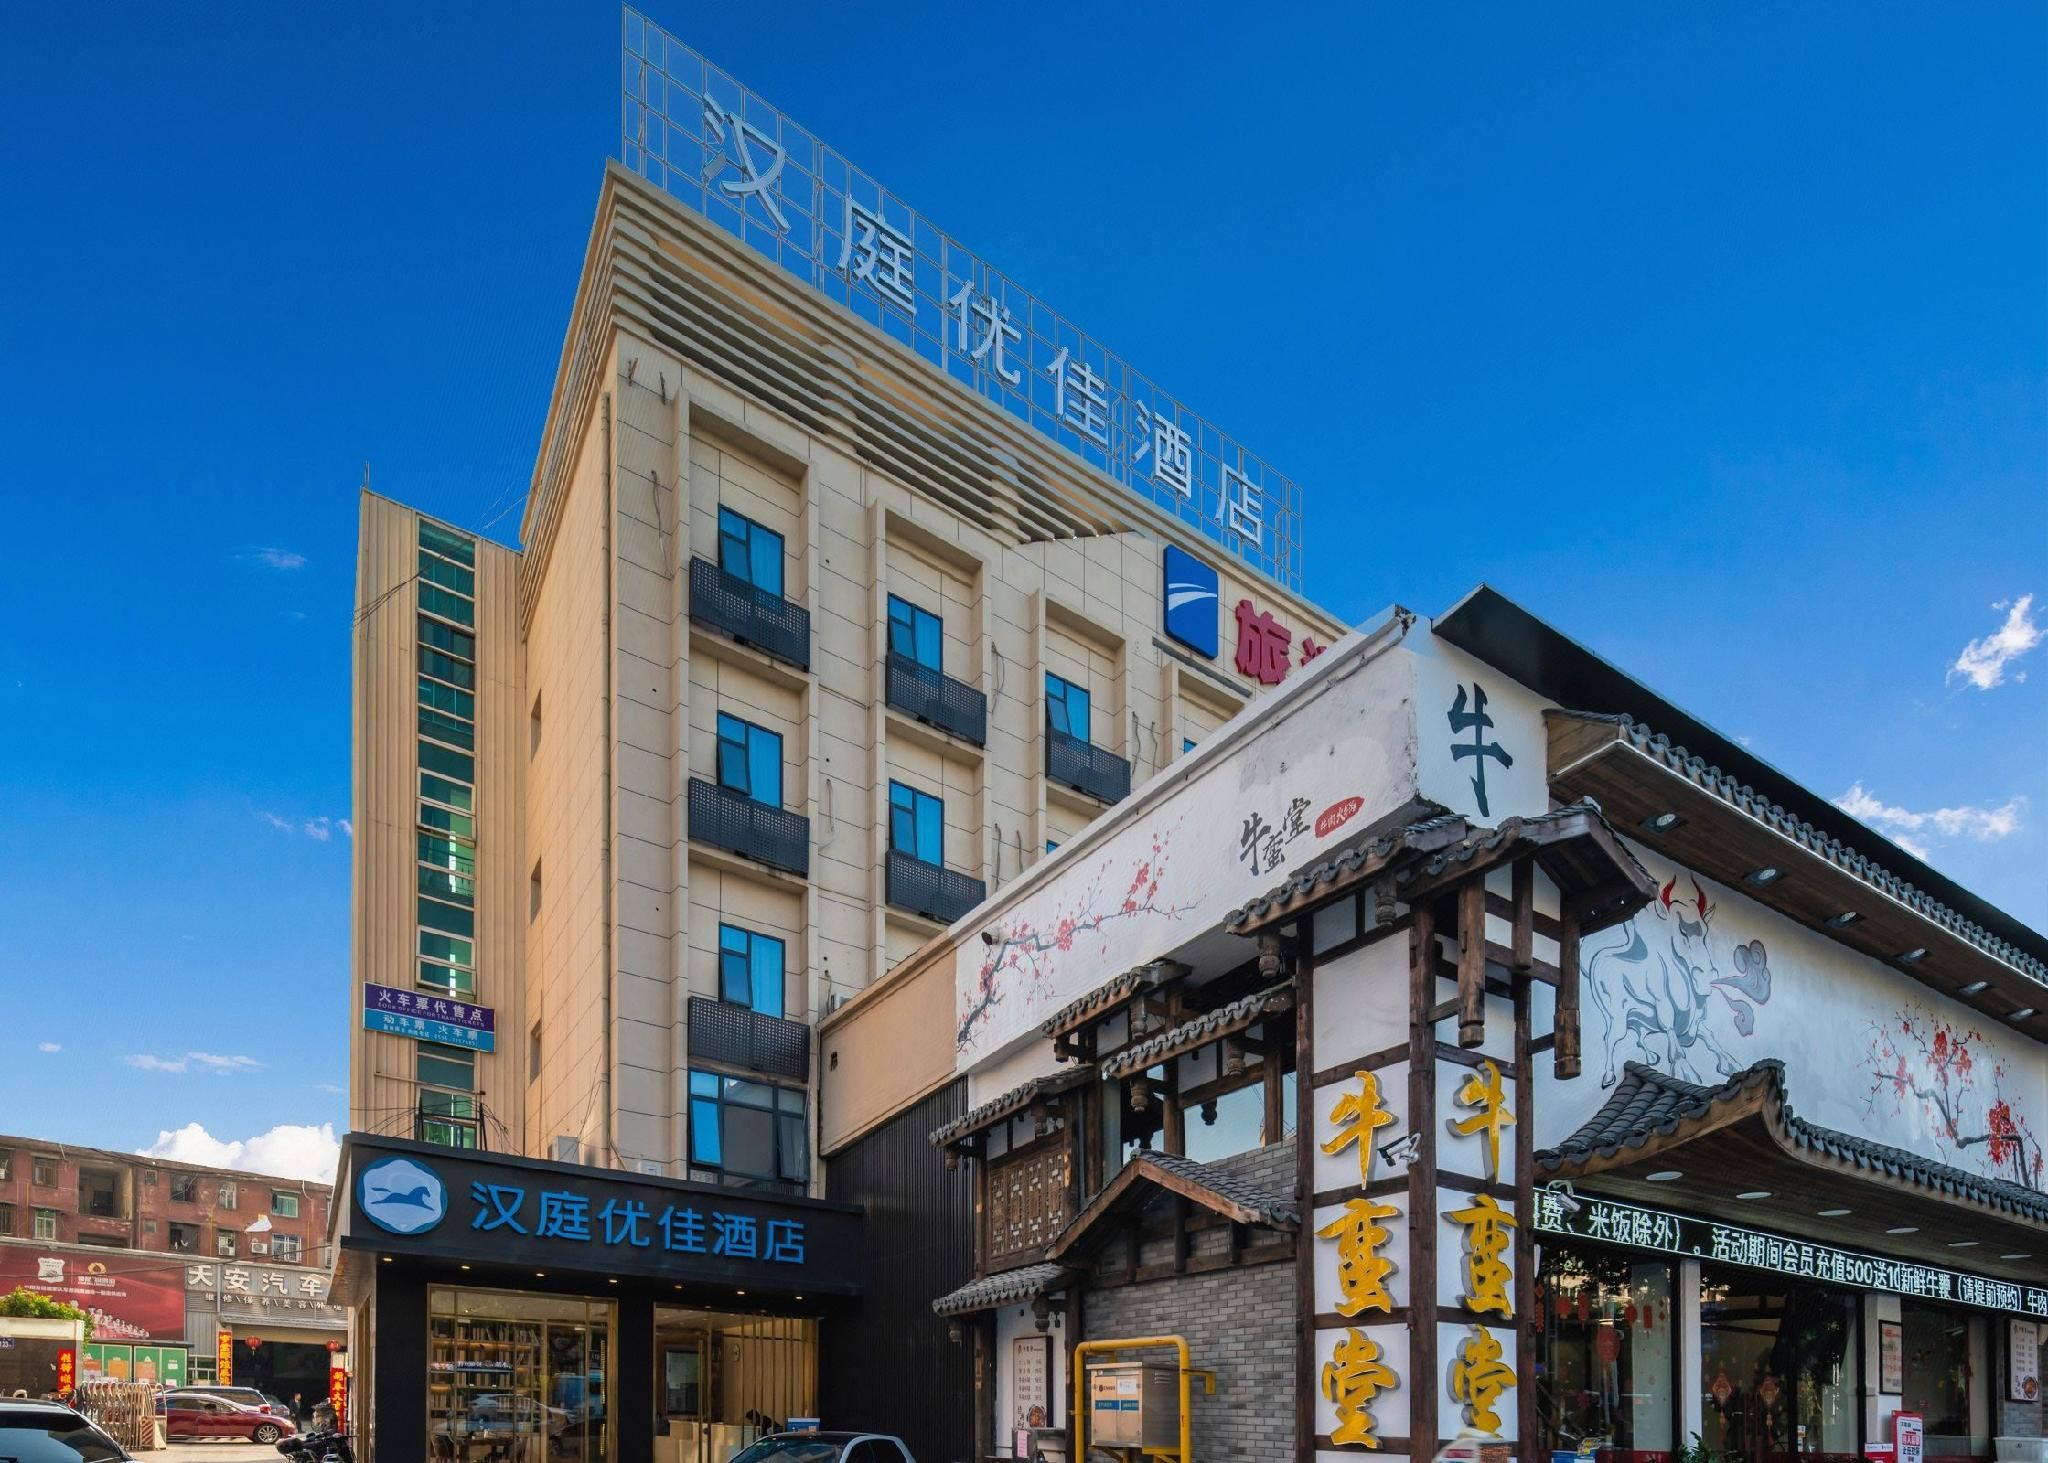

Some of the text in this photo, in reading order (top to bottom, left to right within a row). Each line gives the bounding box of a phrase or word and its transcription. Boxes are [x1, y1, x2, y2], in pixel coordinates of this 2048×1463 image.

[702, 91, 1264, 549] 汉庭优佳酒店
[1447, 682, 1512, 818] 牛
[379, 989, 483, 1022] 火车票代售点
[383, 1014, 425, 1031] 动车票
[438, 1025, 478, 1041] 火车票
[470, 1178, 806, 1264] 汉庭优佳酒店
[188, 1264, 323, 1297] 天安汽车
